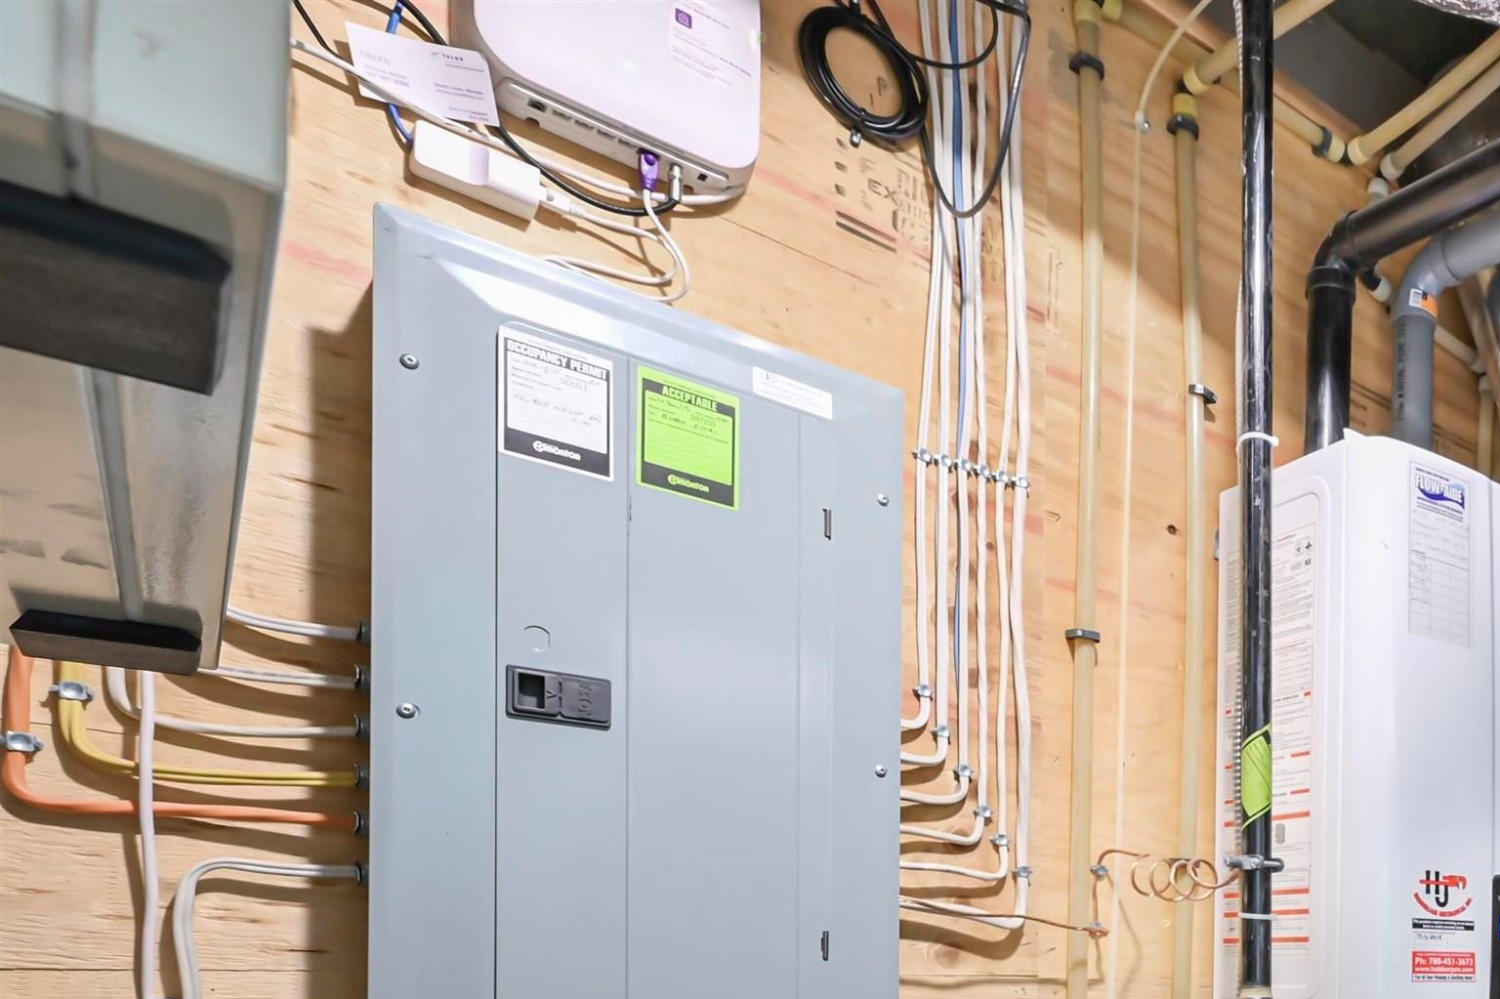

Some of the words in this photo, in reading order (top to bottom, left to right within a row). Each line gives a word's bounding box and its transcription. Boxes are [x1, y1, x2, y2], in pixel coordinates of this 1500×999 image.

[441, 53, 464, 62] TELUS
[507, 339, 568, 369] OCCUPANCY
[569, 358, 608, 381] PERMIT
[662, 385, 718, 412] ACCEPTABLE
[532, 440, 581, 461] Edmonton
[667, 473, 710, 493] Edmonton
